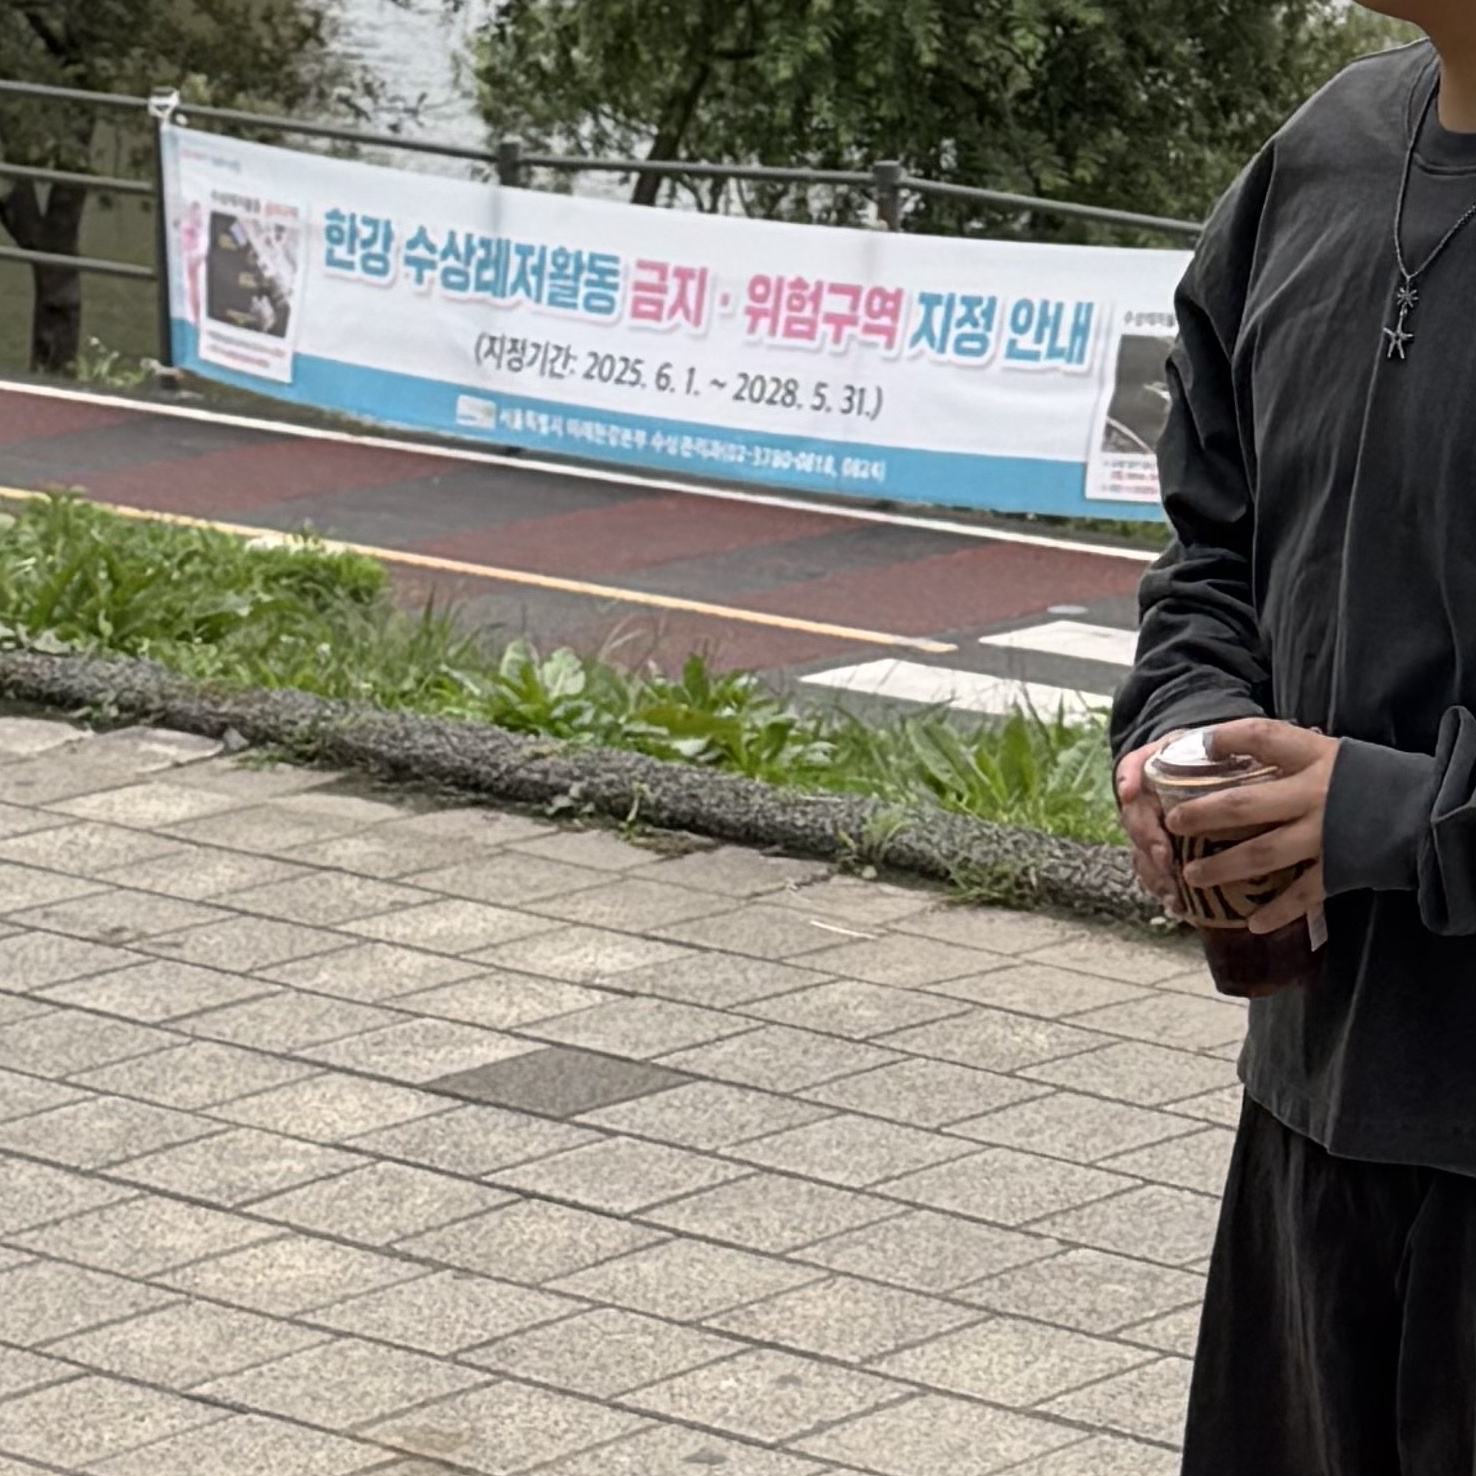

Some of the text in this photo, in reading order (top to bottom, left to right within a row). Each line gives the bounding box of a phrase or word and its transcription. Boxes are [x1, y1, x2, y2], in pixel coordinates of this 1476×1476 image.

[324, 207, 394, 278] 한강
[404, 225, 620, 316] 수상레저활동
[909, 291, 997, 357] 지정
[1004, 298, 1094, 365] 안내
[474, 331, 577, 380] (지정기간:
[583, 351, 647, 389] 2025.
[732, 372, 803, 410] 2028.
